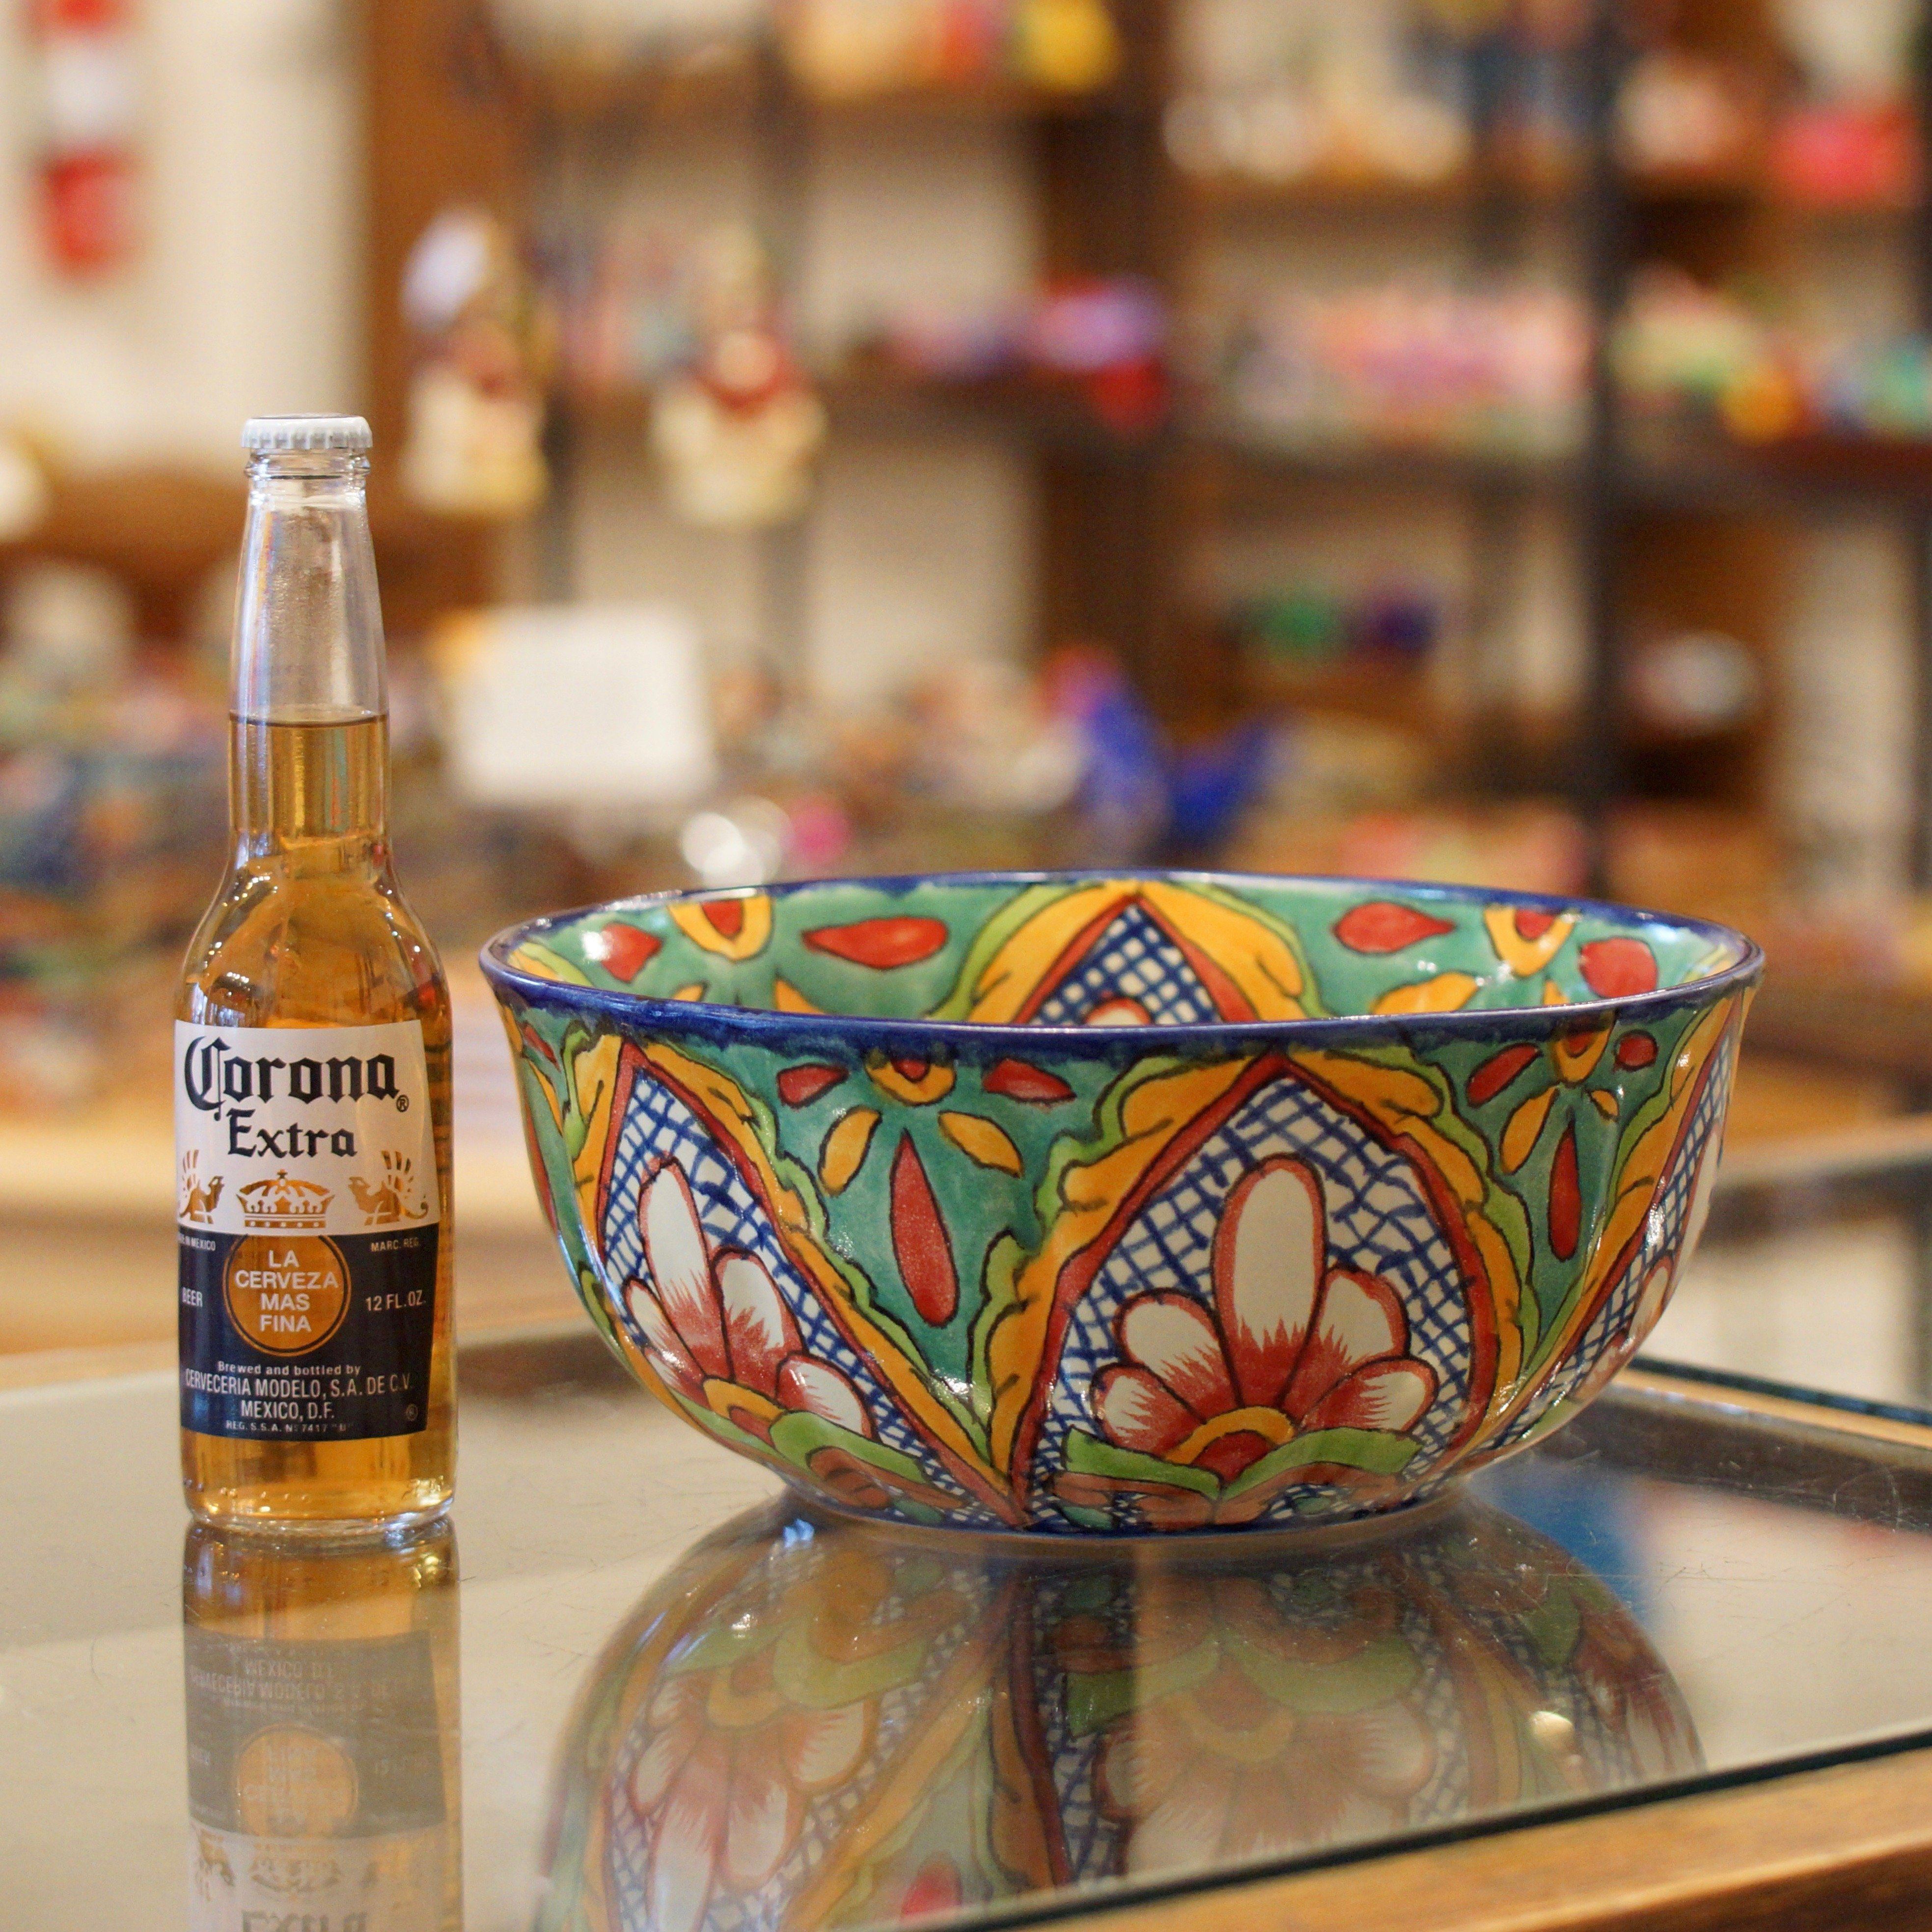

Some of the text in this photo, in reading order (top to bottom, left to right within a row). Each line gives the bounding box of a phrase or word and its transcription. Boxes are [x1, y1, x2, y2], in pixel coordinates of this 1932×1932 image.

[225, 1107, 358, 1158] Extra
[191, 1237, 216, 1251] MEXICO
[268, 1250, 300, 1268] LA
[235, 1270, 339, 1290] CERVEZA
[182, 1287, 203, 1308] BEER
[260, 1293, 311, 1312] MAS
[365, 1296, 383, 1311] 12
[260, 1314, 312, 1332] FINA
[218, 1360, 361, 1377] Brewed and bottled by
[185, 1368, 251, 1396] CERVECERIA
[254, 1378, 327, 1400] MODELO,
[330, 1379, 363, 1397] S.A.
[367, 1375, 385, 1395] DE
[241, 1400, 335, 1422] MEXICO, D.F.
[225, 1420, 248, 1430] REG.
